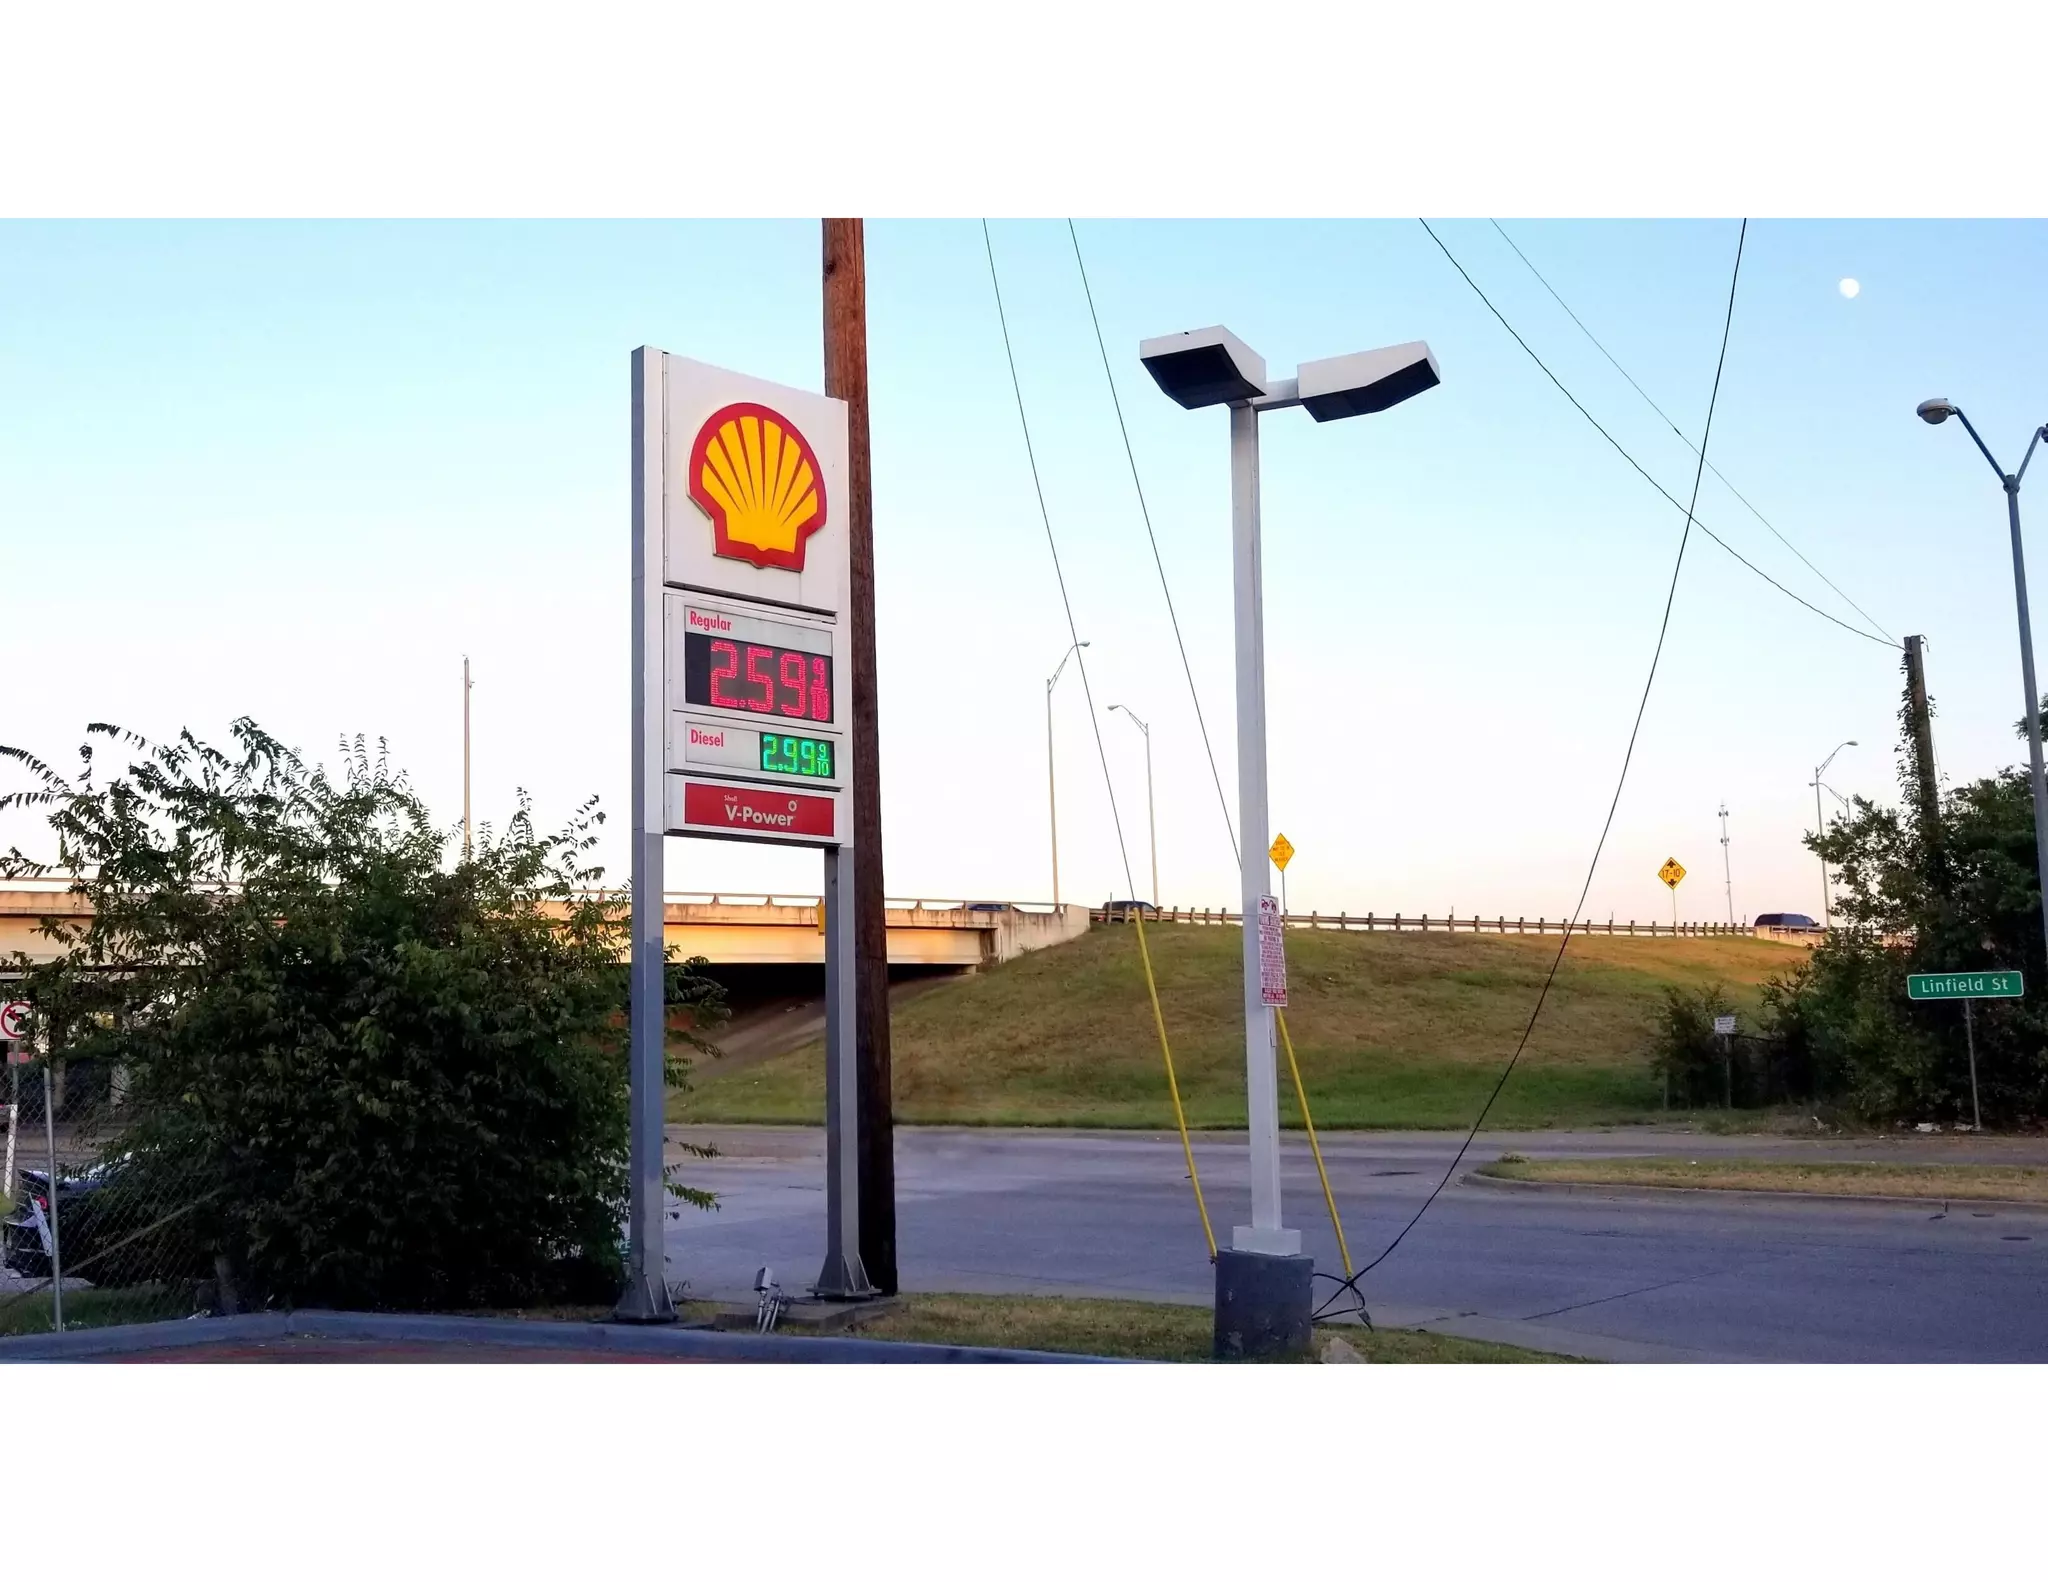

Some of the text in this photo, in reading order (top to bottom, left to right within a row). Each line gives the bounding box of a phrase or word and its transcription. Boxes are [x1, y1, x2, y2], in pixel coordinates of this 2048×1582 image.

[689, 610, 732, 632] Regular
[690, 729, 724, 747] Diesel
[763, 735, 815, 775] 2.99
[724, 804, 794, 826] V-Power
[1921, 977, 2009, 993] Linfield St
